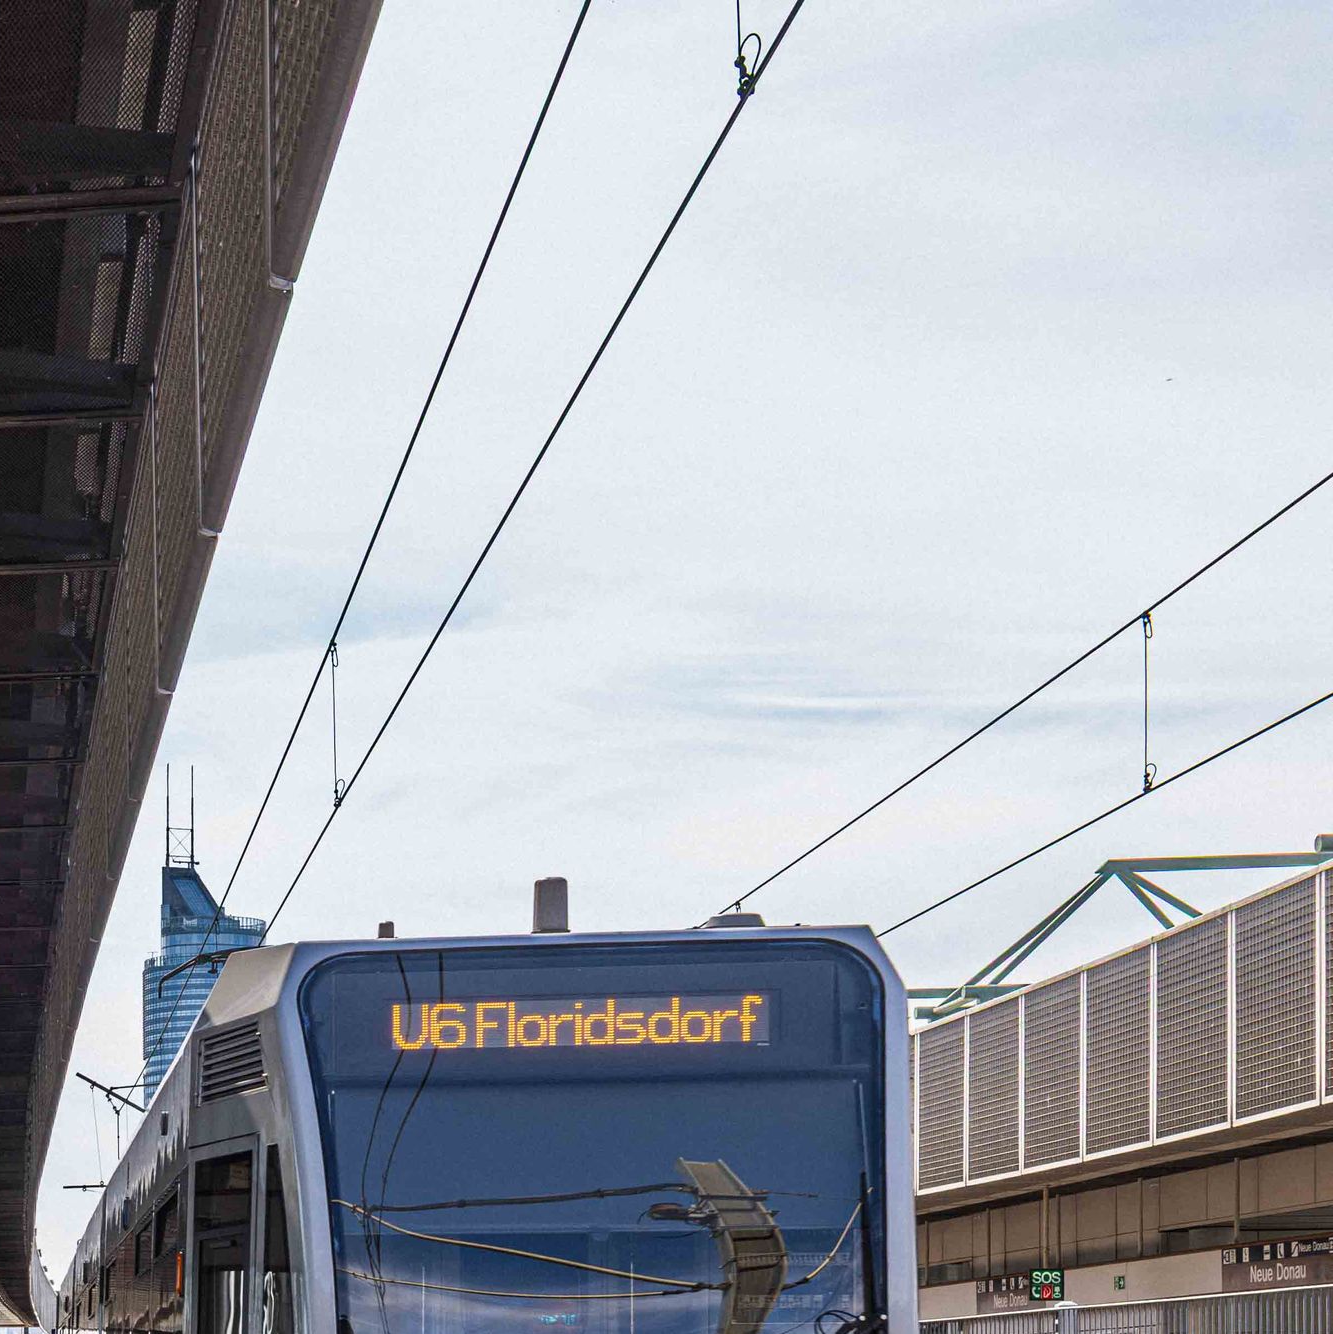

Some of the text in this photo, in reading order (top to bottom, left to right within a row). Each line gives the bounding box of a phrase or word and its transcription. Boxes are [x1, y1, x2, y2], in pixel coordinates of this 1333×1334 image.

[392, 995, 763, 1050] U6 Floridsdorf
[1299, 1243, 1312, 1253] Neue
[1032, 1271, 1061, 1284] SOS
[1250, 1263, 1306, 1283] Neue Donau
[993, 1292, 1028, 1309] Neue Donau
